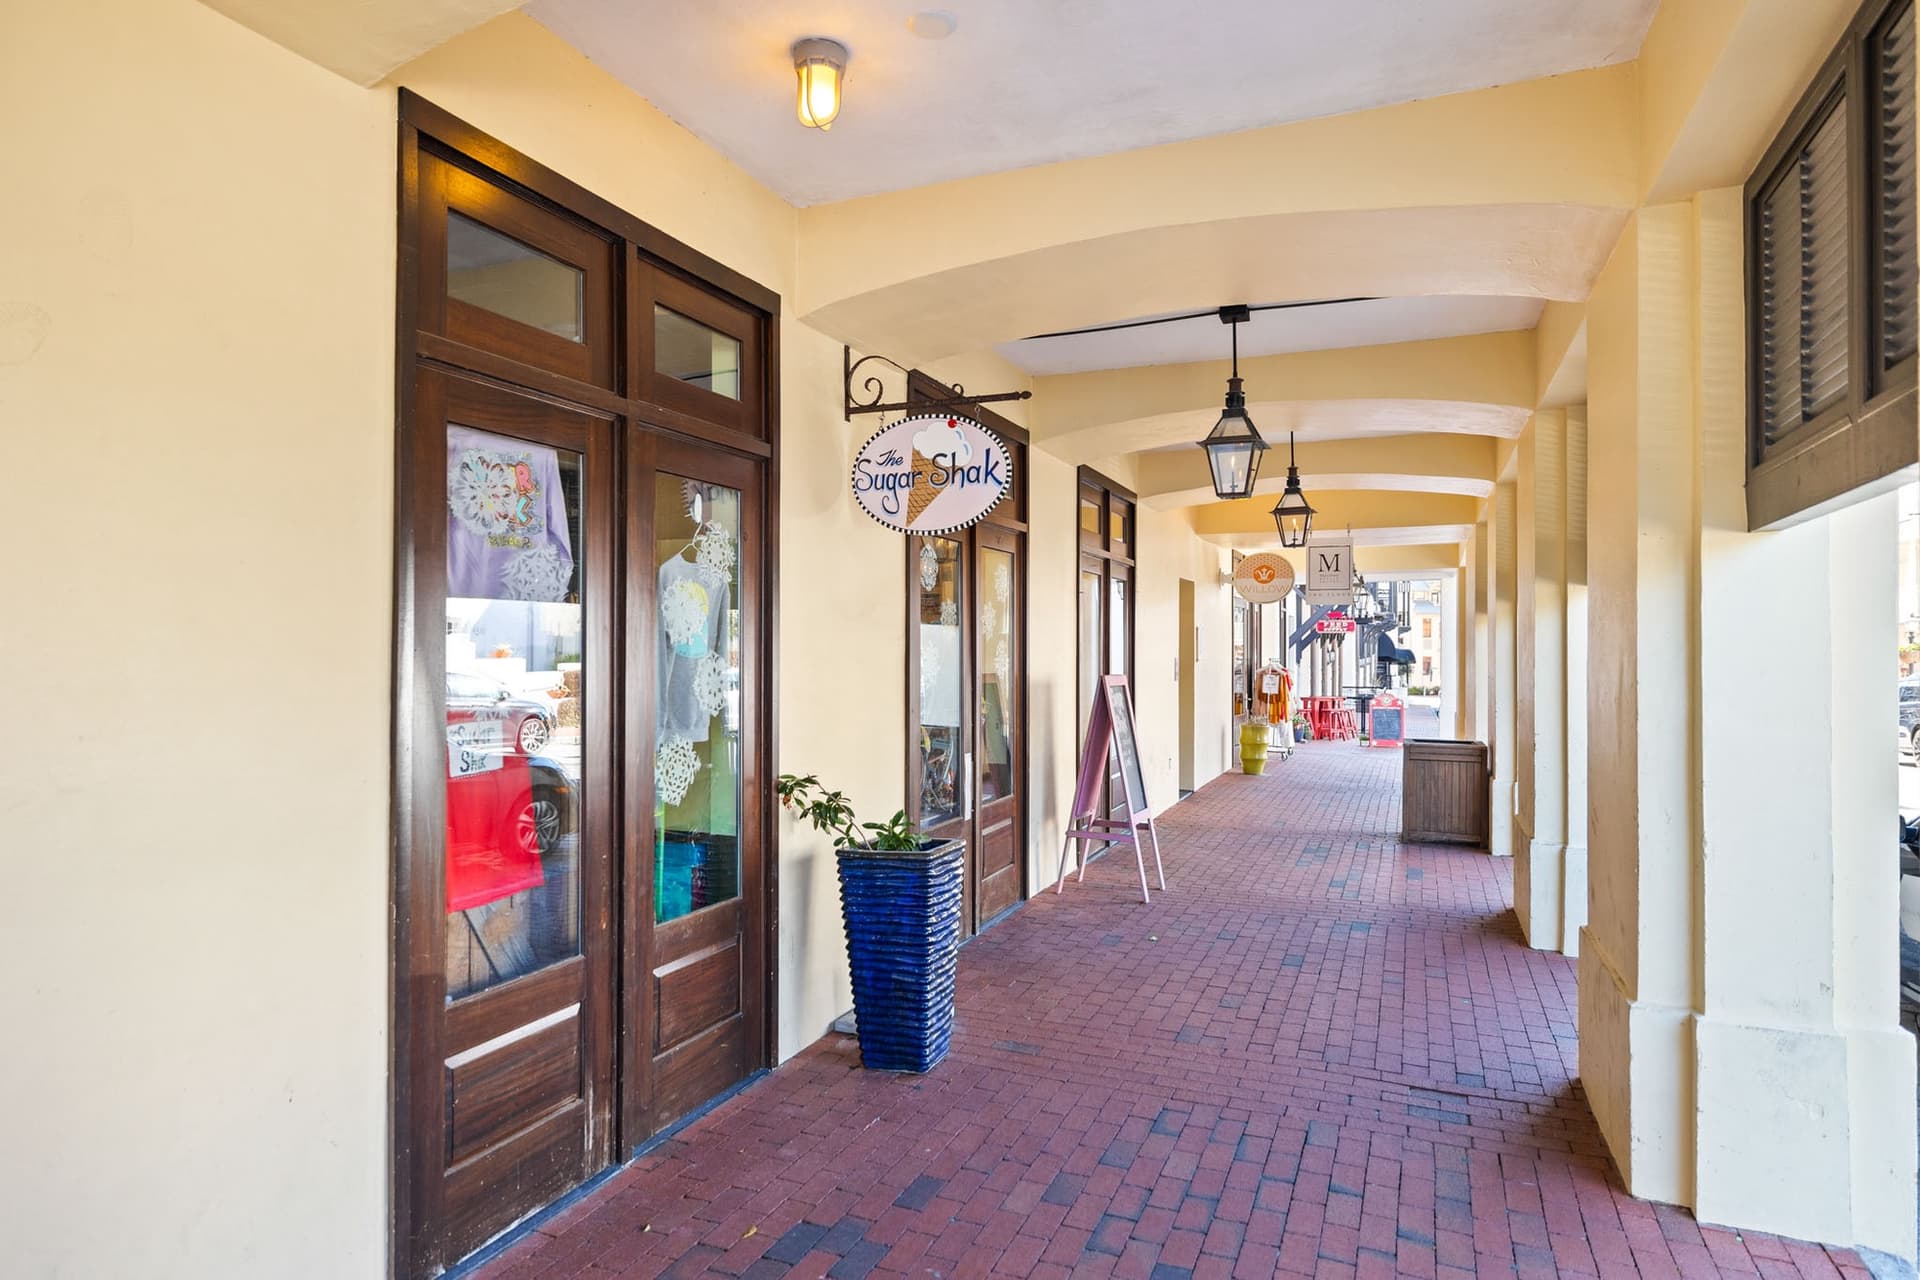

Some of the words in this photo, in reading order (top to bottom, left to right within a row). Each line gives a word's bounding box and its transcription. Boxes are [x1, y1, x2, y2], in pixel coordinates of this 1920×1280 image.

[876, 449, 904, 467] The
[855, 459, 923, 515] Sugar
[929, 448, 1004, 489] Shak
[1319, 554, 1341, 573] M
[1240, 585, 1290, 593] WILLOW
